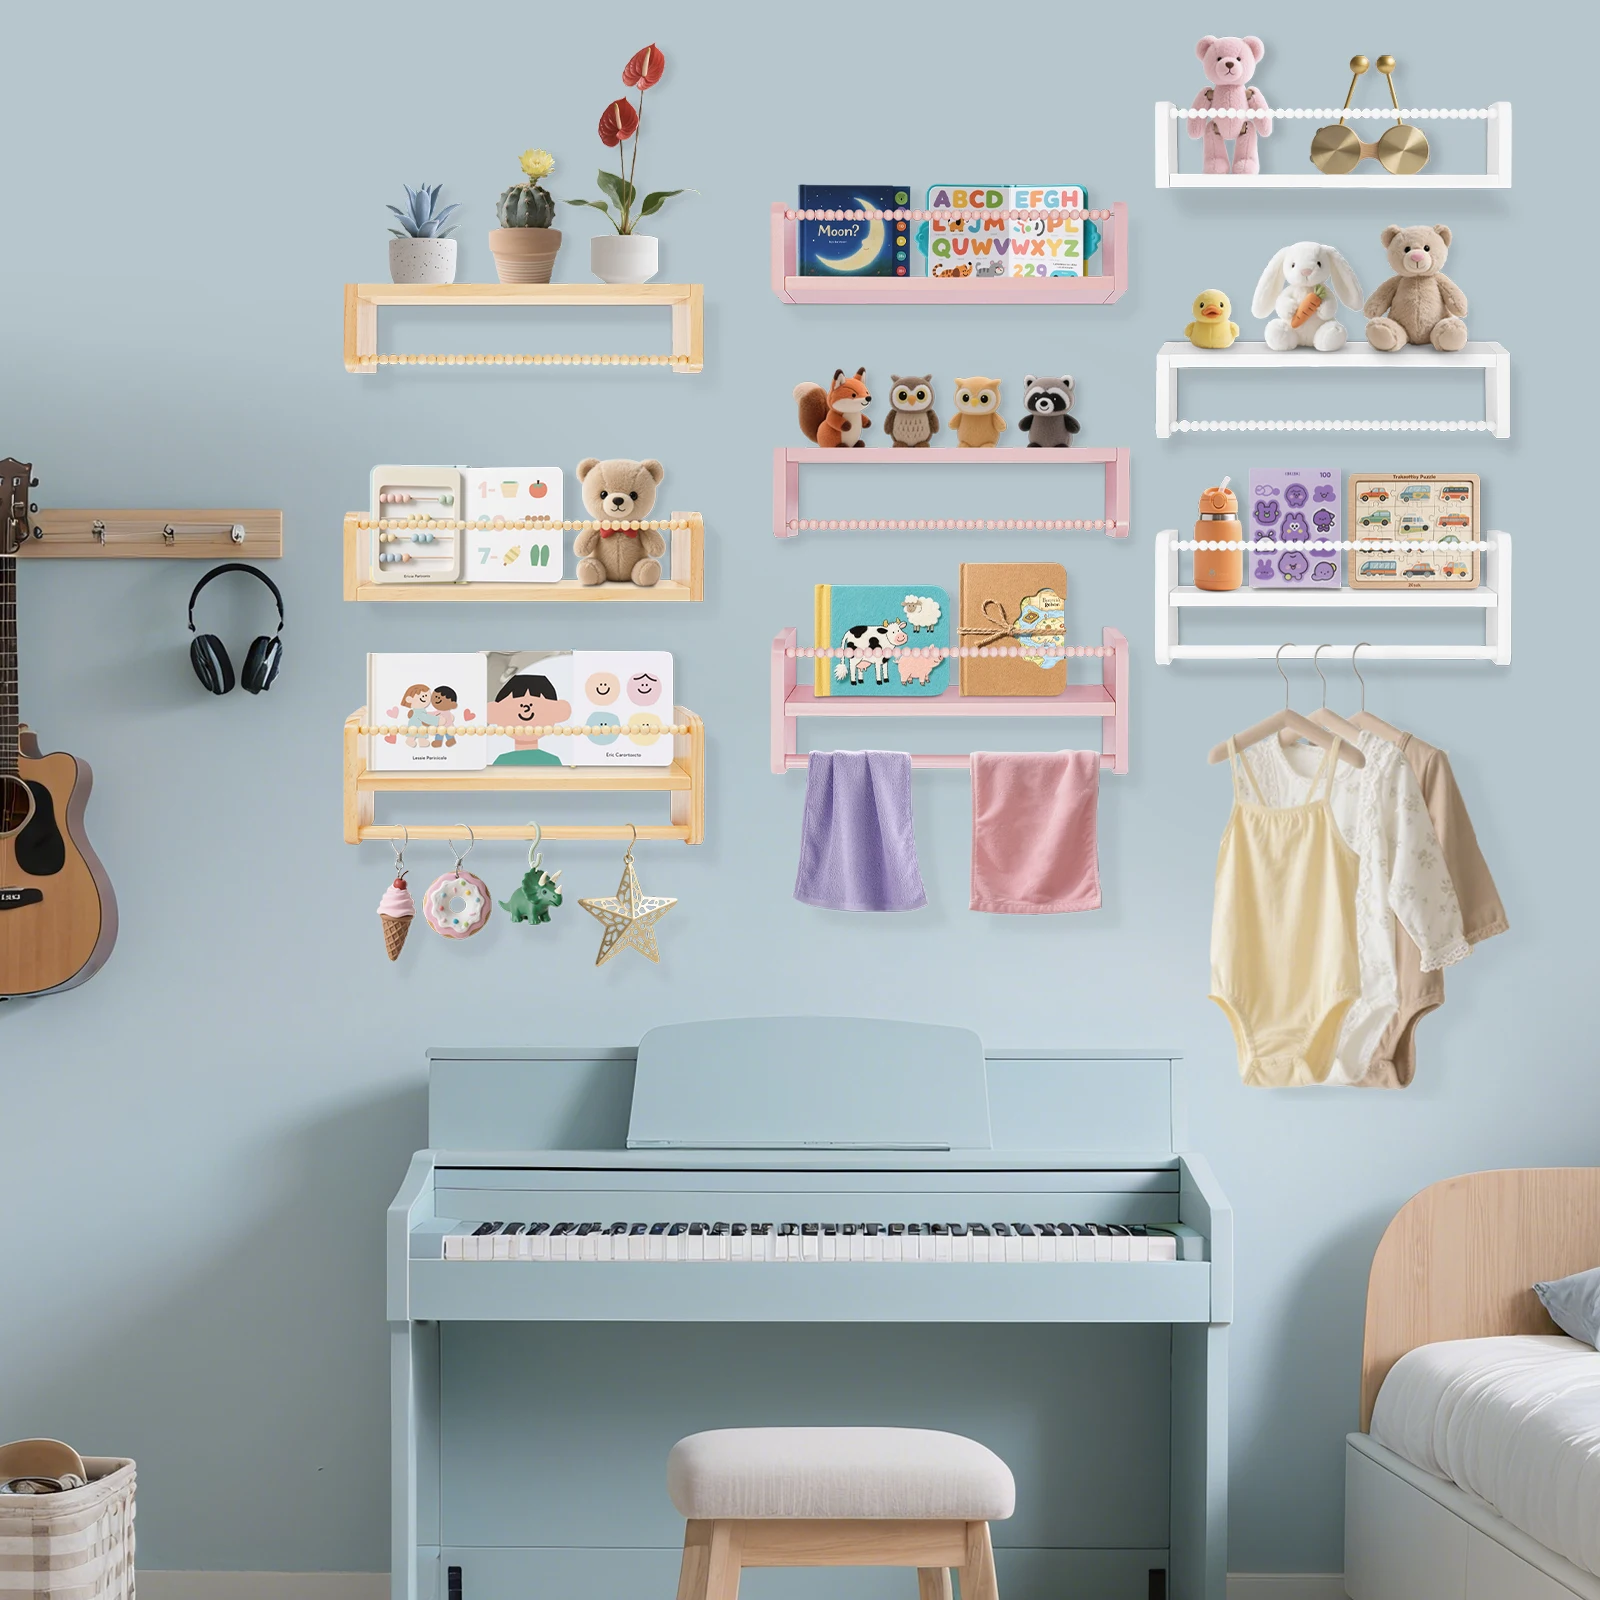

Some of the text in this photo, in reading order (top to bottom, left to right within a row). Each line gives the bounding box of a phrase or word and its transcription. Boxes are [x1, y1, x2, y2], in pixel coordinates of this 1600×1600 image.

[933, 190, 1003, 208] ABCD
[1015, 190, 1078, 208] EFGH
[818, 223, 860, 237] Moon?
[1013, 264, 1047, 277] 229
